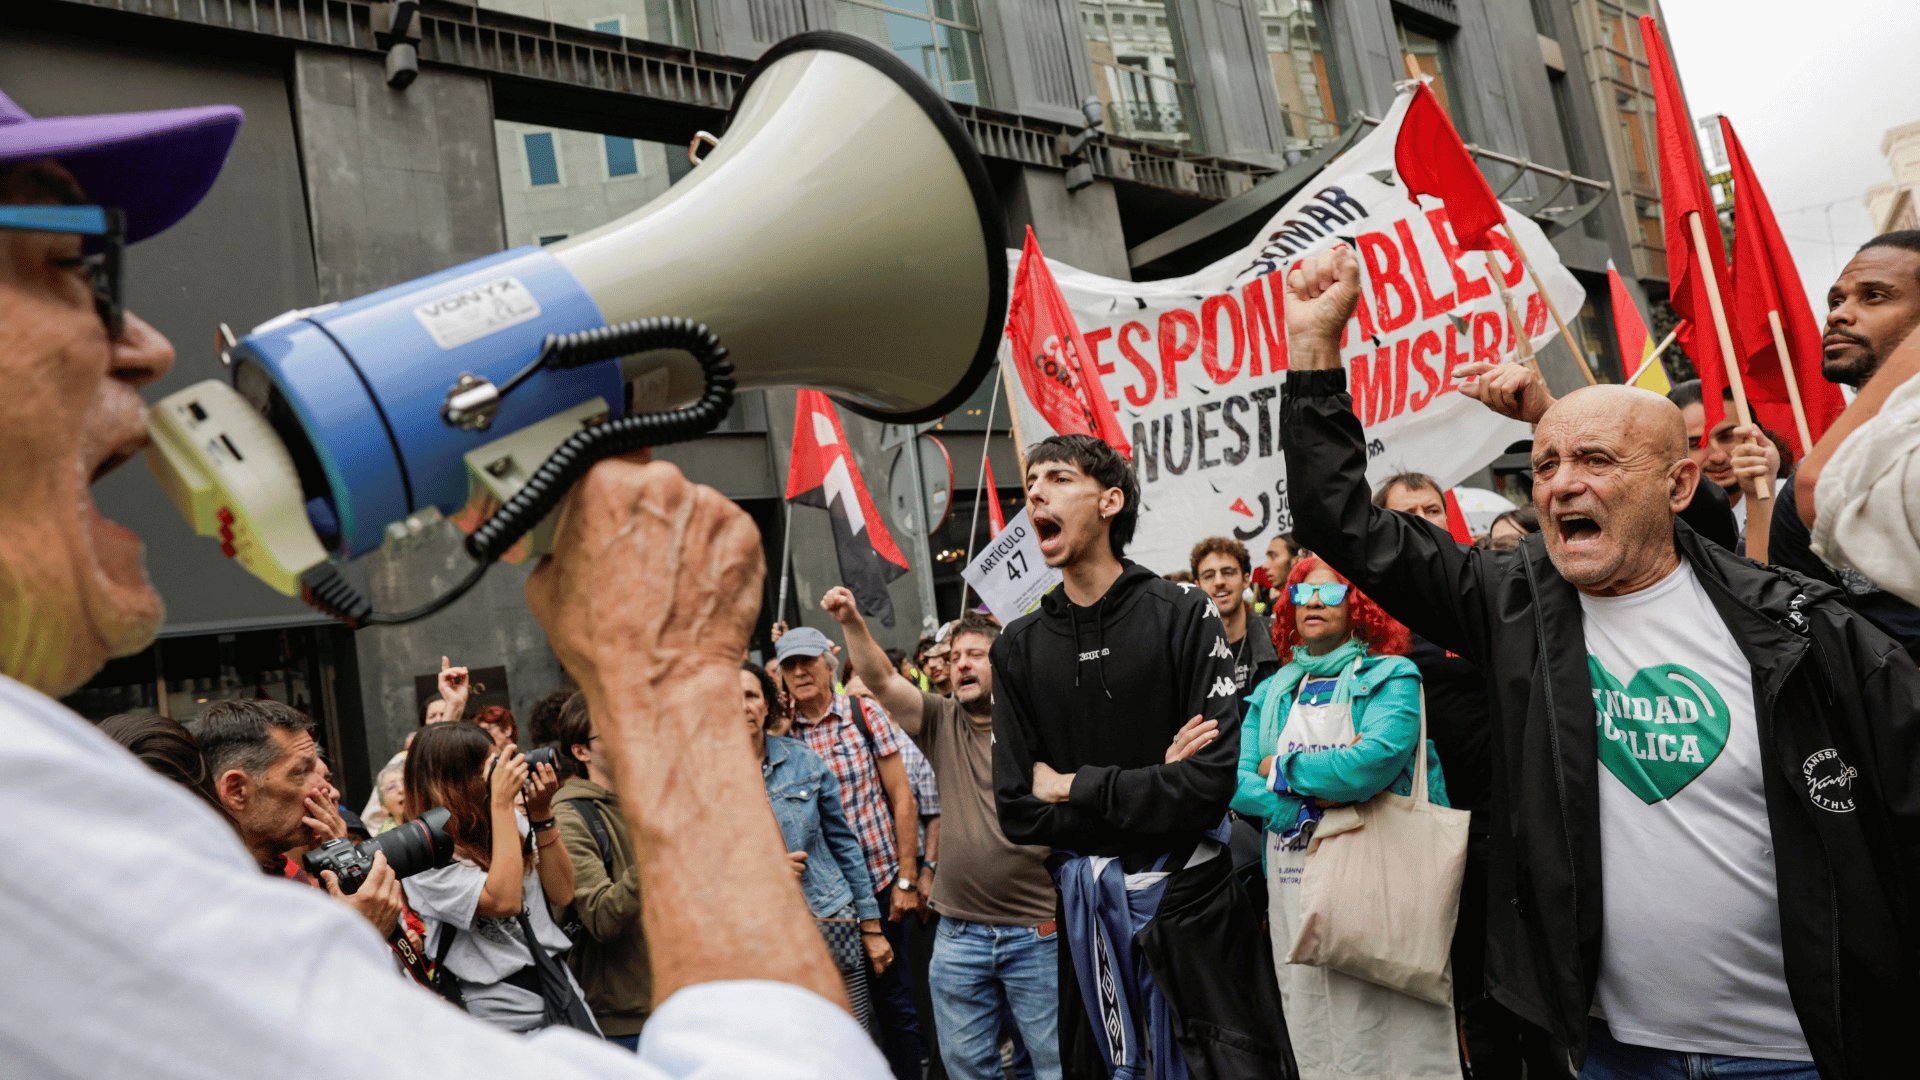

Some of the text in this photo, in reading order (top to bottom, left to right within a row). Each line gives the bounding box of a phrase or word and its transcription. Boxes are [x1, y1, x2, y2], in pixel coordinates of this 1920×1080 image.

[421, 279, 518, 317] VONYX
[1131, 383, 1287, 484] NUEST
[979, 526, 1026, 576] ARTÍCULO
[1006, 549, 1029, 581] 47
[396, 937, 417, 966] EOS
